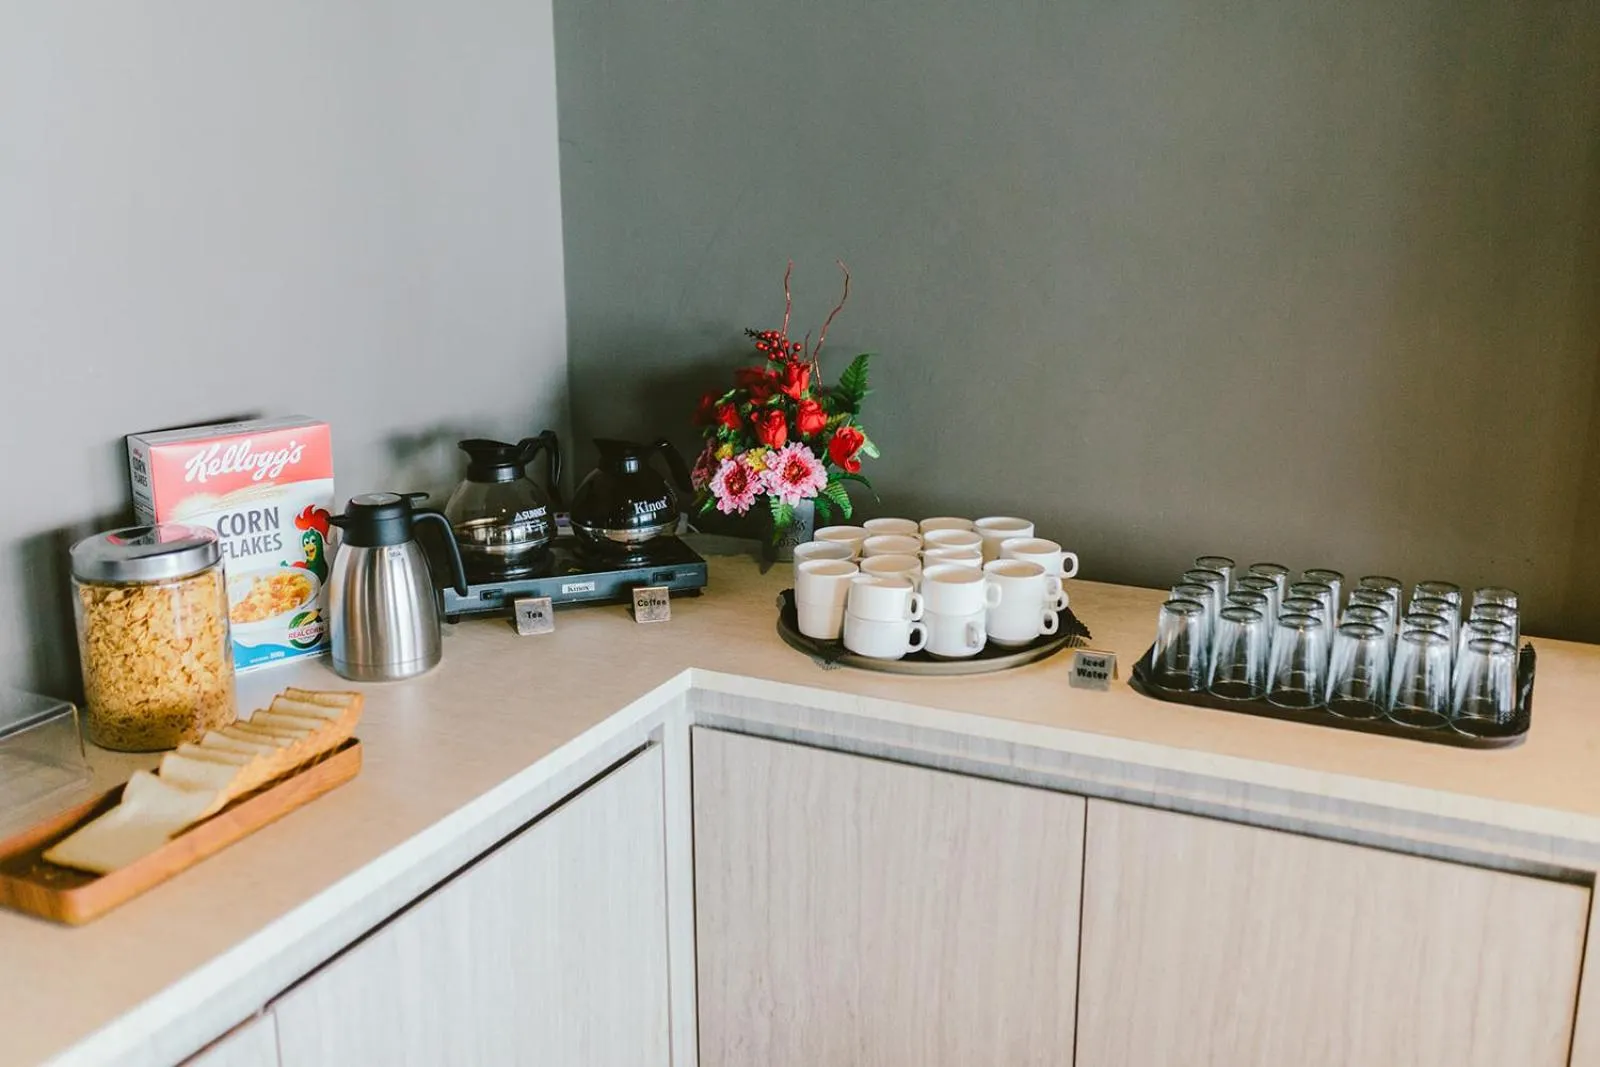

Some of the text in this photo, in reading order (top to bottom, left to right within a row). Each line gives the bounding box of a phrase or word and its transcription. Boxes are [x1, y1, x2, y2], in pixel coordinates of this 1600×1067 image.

[184, 440, 306, 483] Kellogg's
[633, 497, 667, 514] Kinox
[217, 507, 280, 538] CORN
[219, 533, 283, 559] FLAKES
[637, 599, 667, 607] Coffee
[526, 611, 543, 619] Tea
[288, 630, 305, 639] REAL
[305, 625, 324, 635] CORN
[1082, 658, 1105, 667] Iced
[1077, 668, 1108, 680] Water
